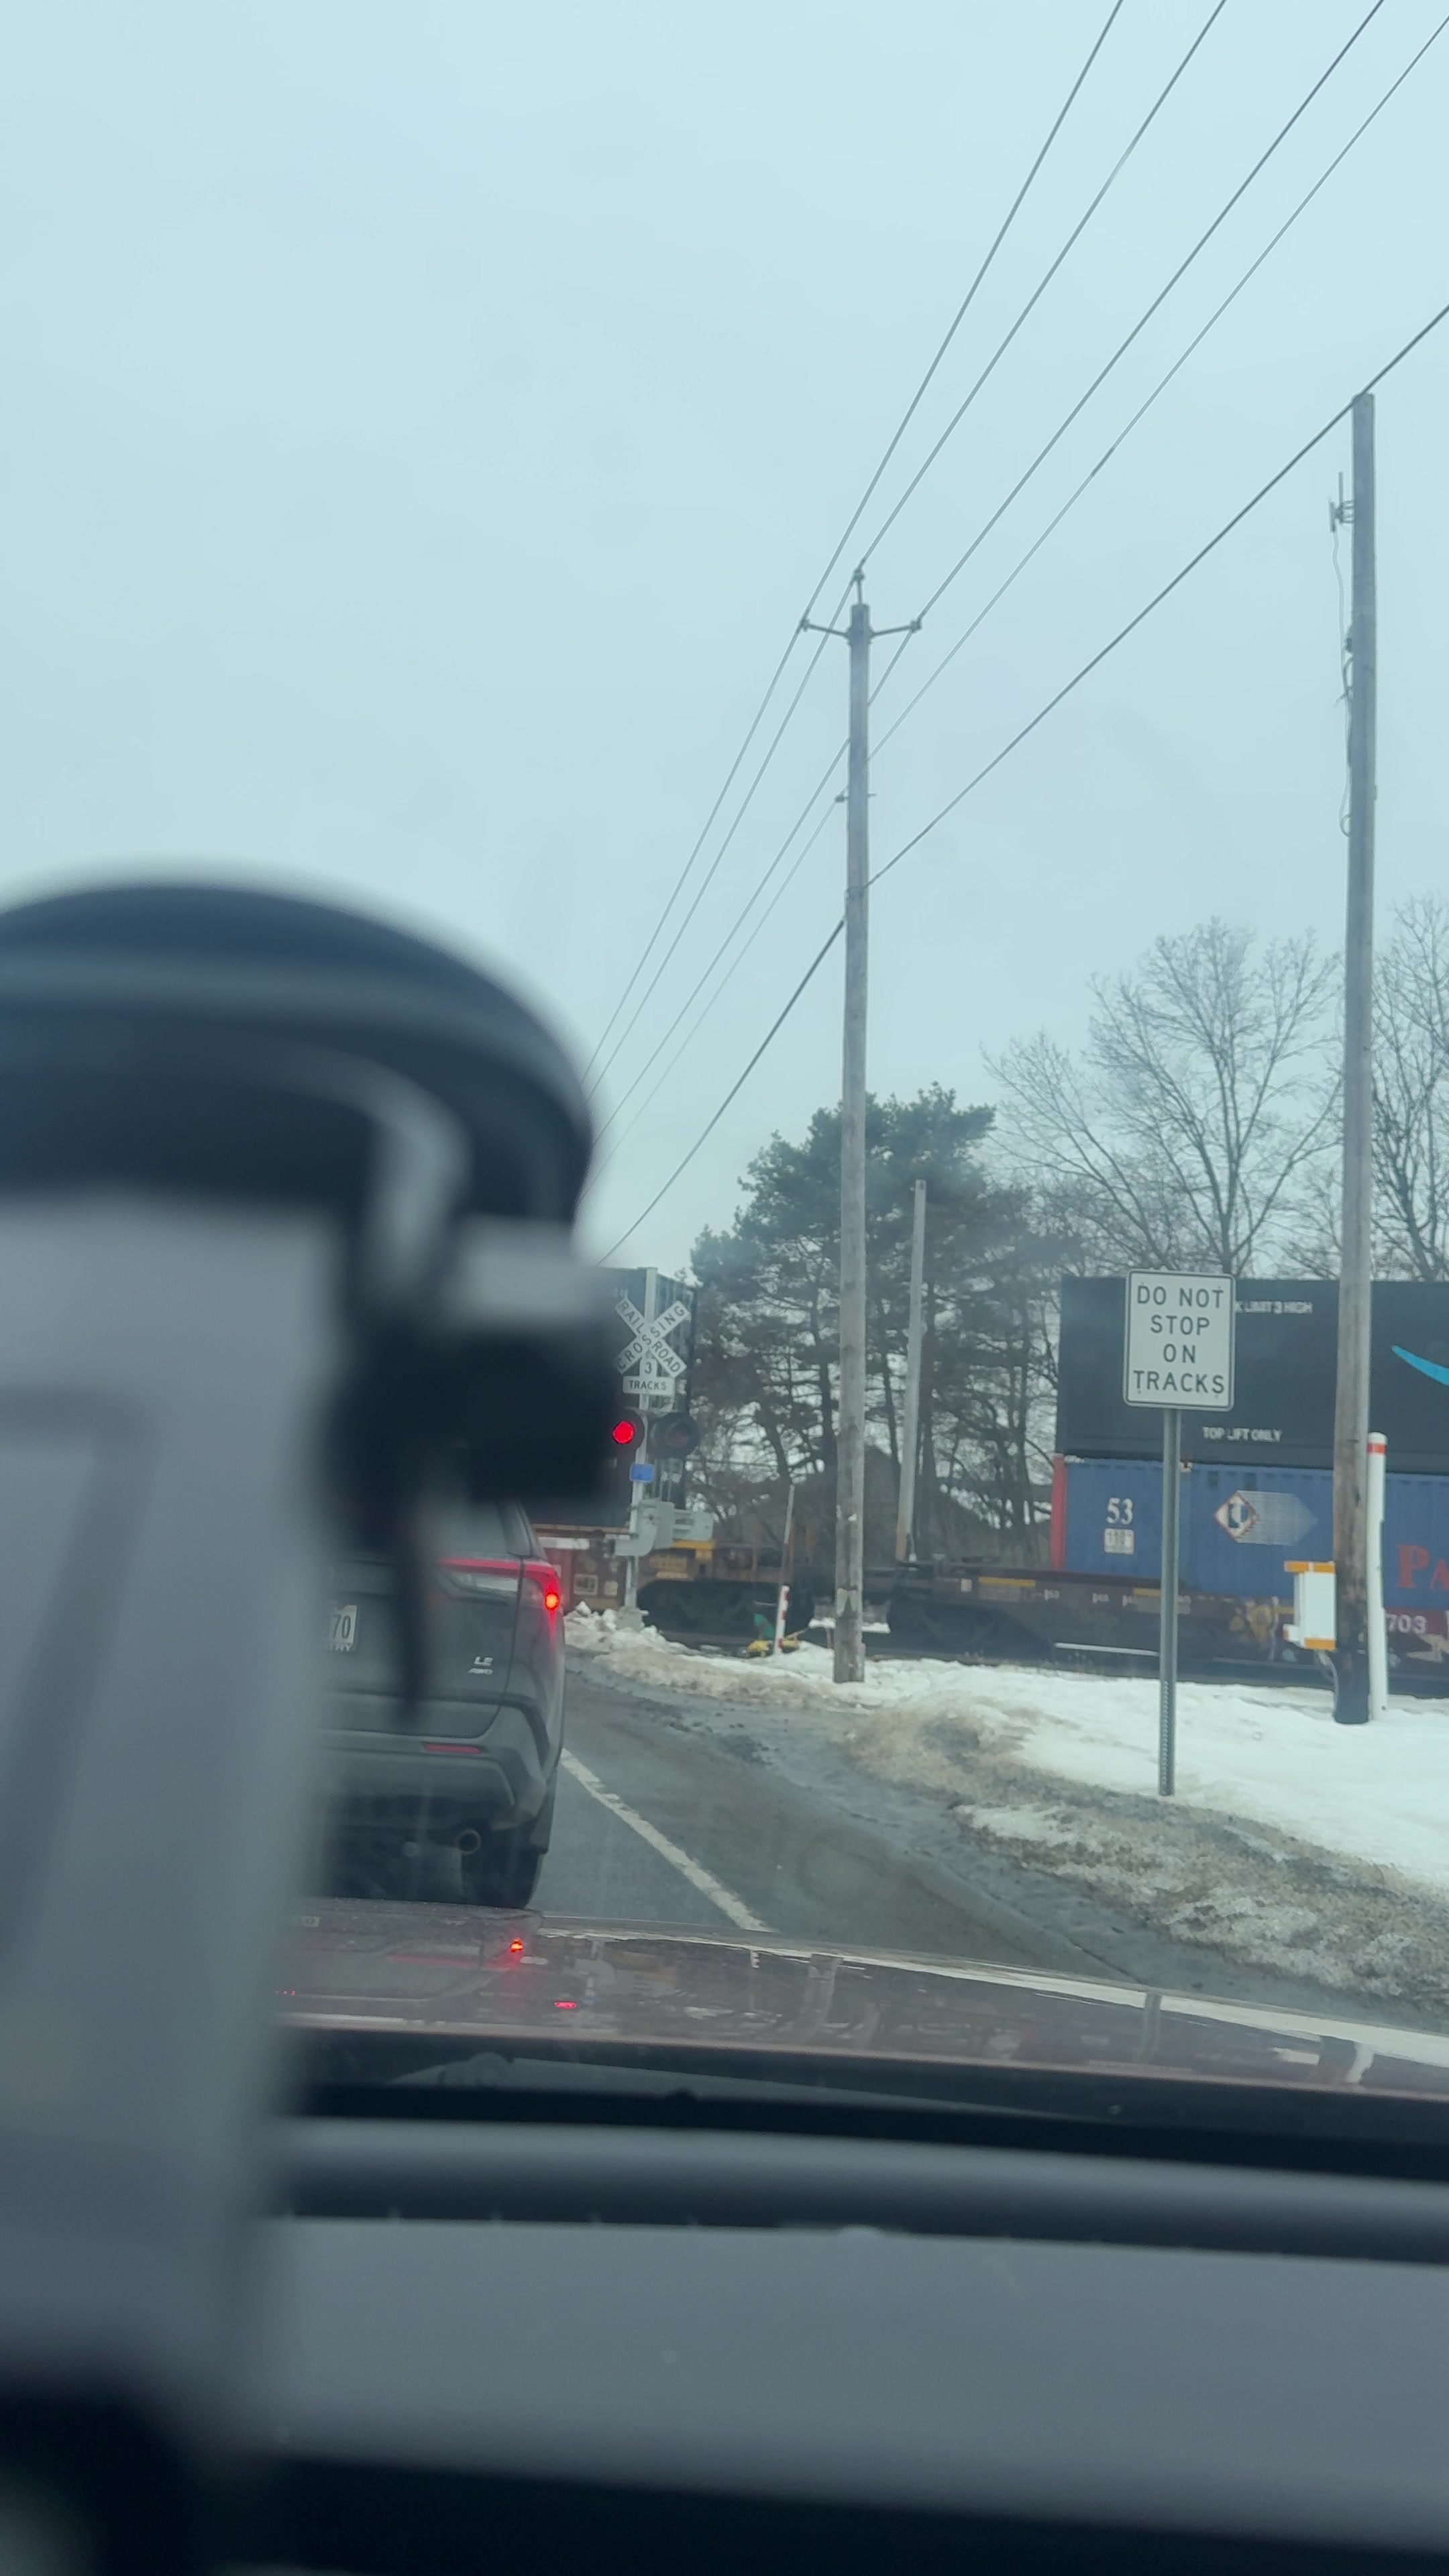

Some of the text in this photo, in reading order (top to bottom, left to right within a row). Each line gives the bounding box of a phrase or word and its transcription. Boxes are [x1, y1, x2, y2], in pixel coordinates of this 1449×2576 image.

[1137, 1285, 1224, 1309] DO NOT
[1150, 1313, 1210, 1336] STOP
[616, 1305, 686, 1371] CROSSING
[1163, 1343, 1196, 1364] ON
[644, 1361, 653, 1375] 3
[629, 1379, 667, 1391] TRACKS
[1133, 1370, 1225, 1394] TRACKS
[1202, 1426, 1225, 1440] TOP
[1251, 1429, 1283, 1442] ONLY
[1105, 1497, 1134, 1525] 53
[474, 1656, 494, 1666] LE
